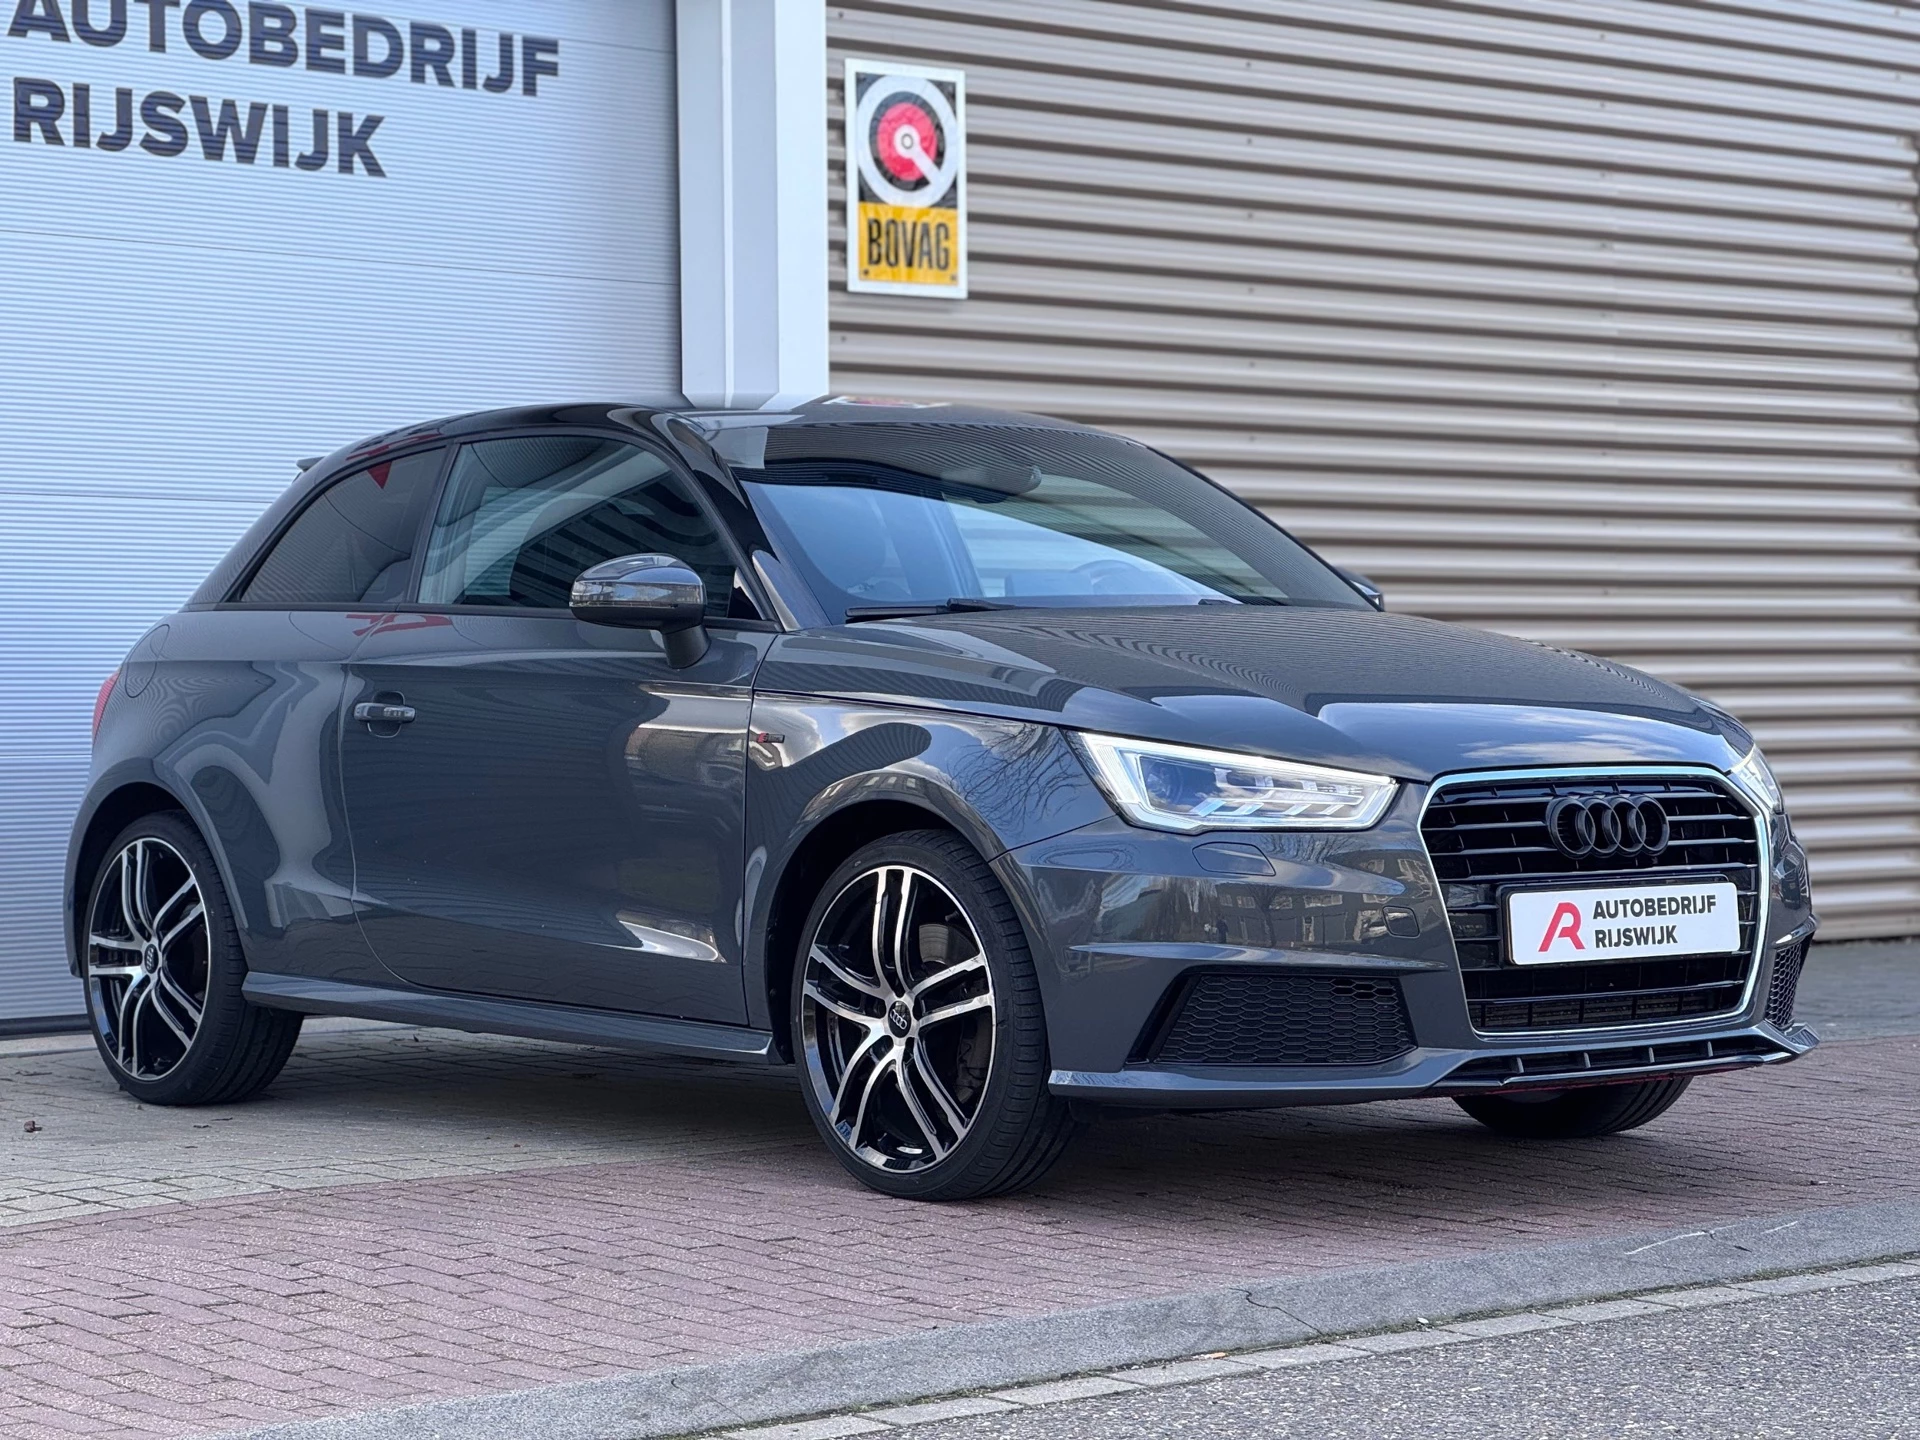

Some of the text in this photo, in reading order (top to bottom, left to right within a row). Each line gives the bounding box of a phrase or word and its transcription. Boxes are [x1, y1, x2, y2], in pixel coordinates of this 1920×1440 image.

[7, 0, 559, 97] AUTOBEDRIJF
[13, 76, 388, 178] RIJSWIJK
[867, 217, 950, 271] BOVAG
[1593, 894, 1717, 920] AUTOBEDRIJF
[1594, 925, 1679, 949] RIJSWIJK
